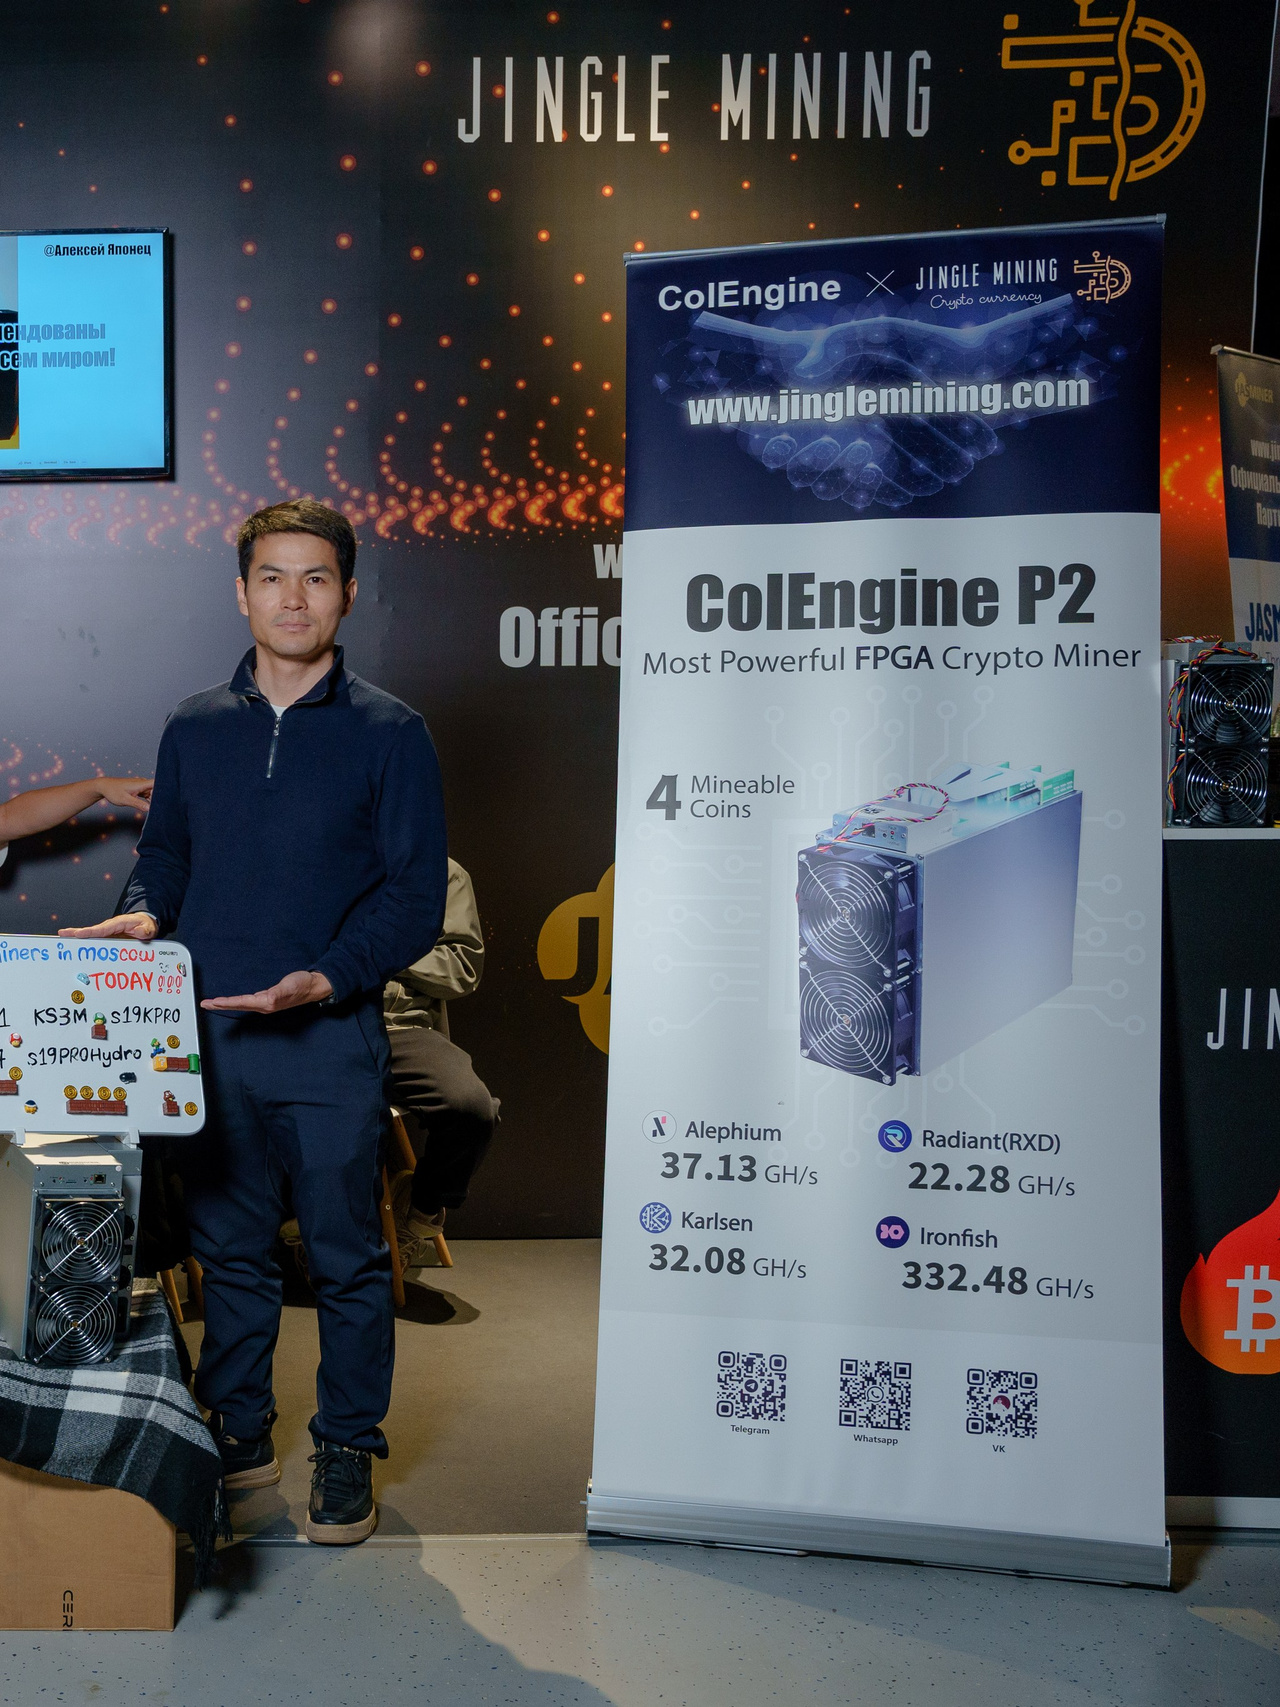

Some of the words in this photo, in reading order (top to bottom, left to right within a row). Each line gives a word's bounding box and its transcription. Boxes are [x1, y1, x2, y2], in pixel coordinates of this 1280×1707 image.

[457, 54, 671, 144] JINGLE
[719, 49, 933, 142] MINING
[43, 243, 105, 258] @Алексей
[107, 243, 152, 258] Японец
[915, 263, 980, 290] JINGLE
[993, 258, 1058, 285] MINING
[658, 276, 842, 312] ColEngine
[930, 293, 974, 310] Crypto
[979, 292, 1042, 304] currency
[41, 347, 116, 370] миром!
[688, 377, 1090, 427] www.jinglemining.com
[685, 568, 999, 635] ColEngine
[1018, 562, 1097, 626] P2
[643, 648, 711, 676] Most
[720, 645, 845, 674] Powerful
[855, 645, 935, 671] FPGA
[942, 643, 1044, 677] Crypto
[1054, 642, 1141, 668] Miner
[690, 774, 795, 795] Mineable
[645, 773, 682, 821] 4
[689, 799, 752, 820] Coins
[58, 942, 72, 961] in
[78, 945, 155, 963] moscow
[90, 971, 153, 993] TODAY
[34, 1007, 88, 1027] KS3M
[685, 1120, 782, 1143] Alephium
[922, 1129, 1061, 1154] Radiant(RXD)
[660, 1151, 757, 1183] 37.13
[764, 1164, 819, 1186] GH/s
[908, 1161, 1010, 1194] 22.28
[1018, 1174, 1076, 1198] GH/s
[681, 1211, 754, 1233] Karlsen
[920, 1227, 998, 1249] Ironfish
[649, 1243, 746, 1275] 32.08
[753, 1258, 807, 1280] GH/s
[902, 1261, 1029, 1296] 332.48
[1036, 1277, 1094, 1300] GH/s
[730, 1424, 770, 1436] Telegram
[853, 1434, 899, 1446] Whatsapp
[992, 1444, 1006, 1453] VK
